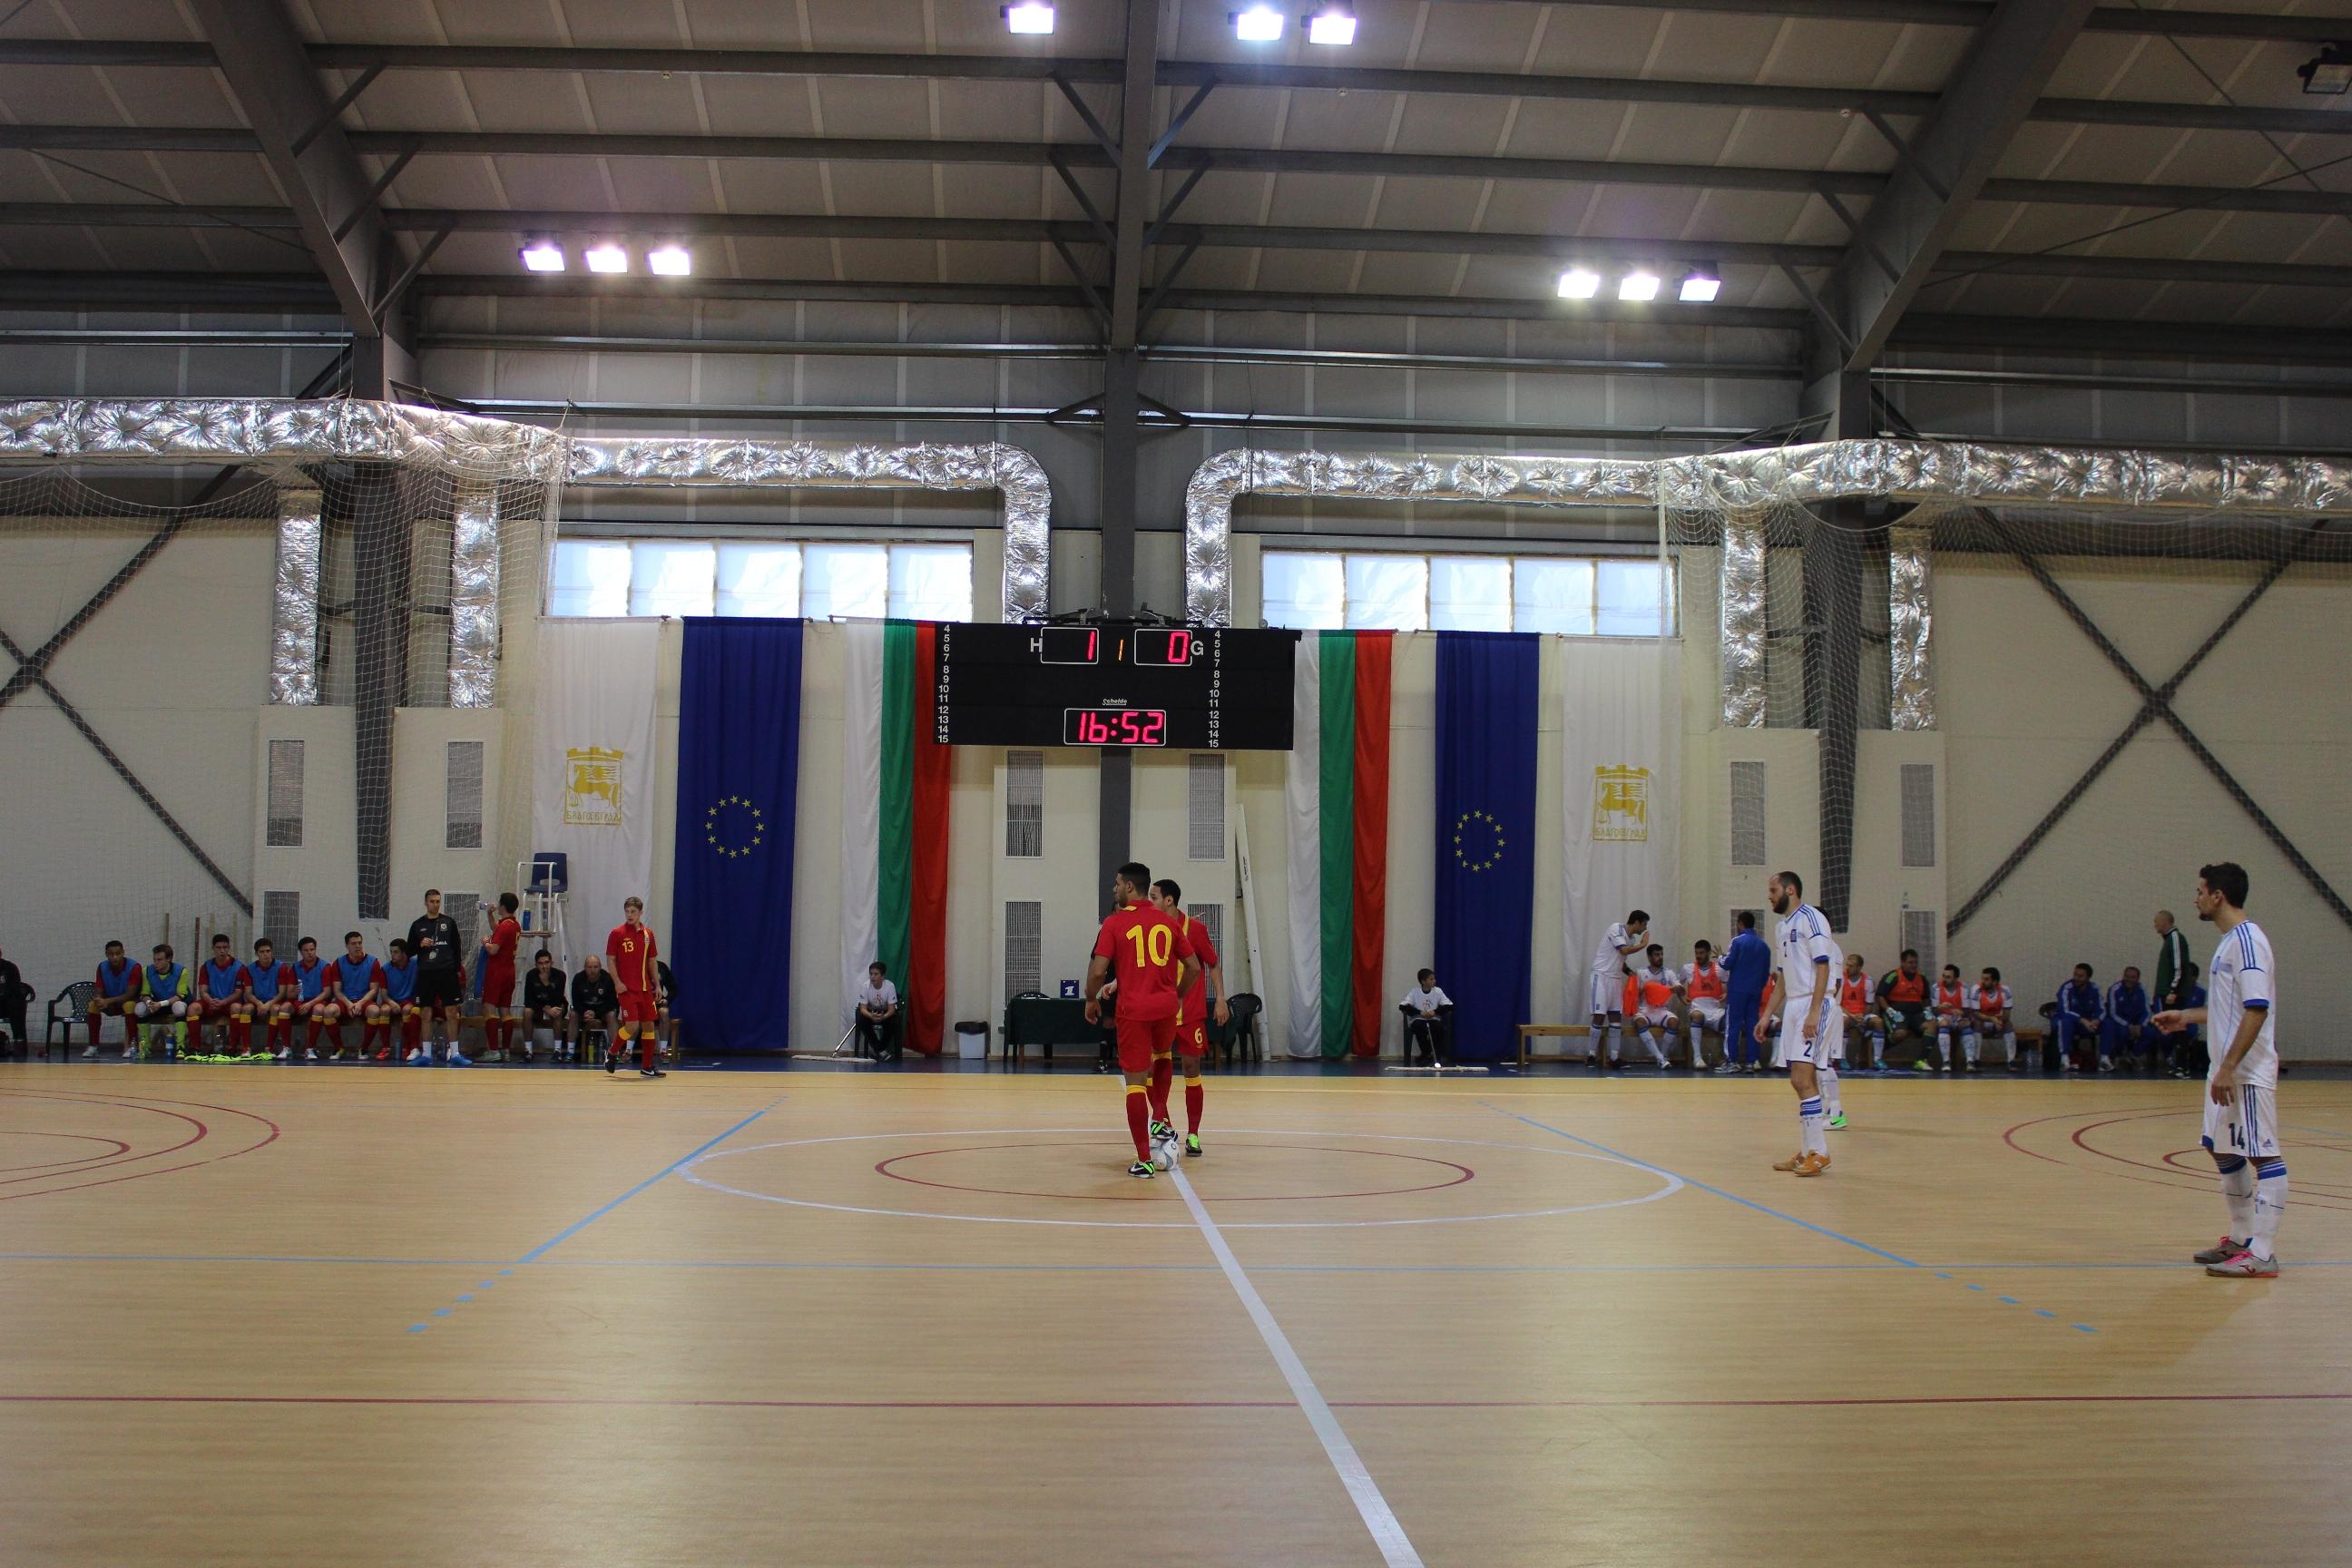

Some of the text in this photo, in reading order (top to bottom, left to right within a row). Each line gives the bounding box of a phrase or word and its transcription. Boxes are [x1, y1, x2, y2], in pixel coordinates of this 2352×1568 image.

[944, 624, 950, 632] 4
[944, 633, 950, 642] 5
[1214, 630, 1220, 638] 4
[943, 643, 950, 652] 6
[1031, 638, 1043, 652] H
[1088, 631, 1095, 661] 1
[1167, 631, 1189, 663] 0
[1214, 640, 1220, 648] 5
[1191, 641, 1204, 656] G
[944, 653, 950, 662] 7
[1214, 650, 1220, 658] 6
[1214, 659, 1220, 667] 7
[943, 665, 950, 673] 8
[943, 675, 950, 683] 9
[1214, 671, 1220, 679] 8
[1213, 680, 1220, 688] 9
[938, 694, 949, 702] 11
[1209, 690, 1220, 698] 10
[1209, 700, 1219, 708] 11
[938, 706, 949, 714] 12
[1209, 710, 1219, 719] 12
[937, 716, 949, 724] 13
[1078, 711, 1164, 743] 16:52
[1209, 720, 1219, 729] 13
[937, 725, 949, 733] 14
[1208, 730, 1219, 739] 14
[937, 735, 949, 743] 15
[1208, 740, 1219, 748] 15
[622, 941, 634, 953] 13
[1125, 924, 1171, 967] 10
[1194, 1027, 1203, 1044] 6
[1803, 1039, 1813, 1059] 2
[2228, 1122, 2246, 1150] 14
